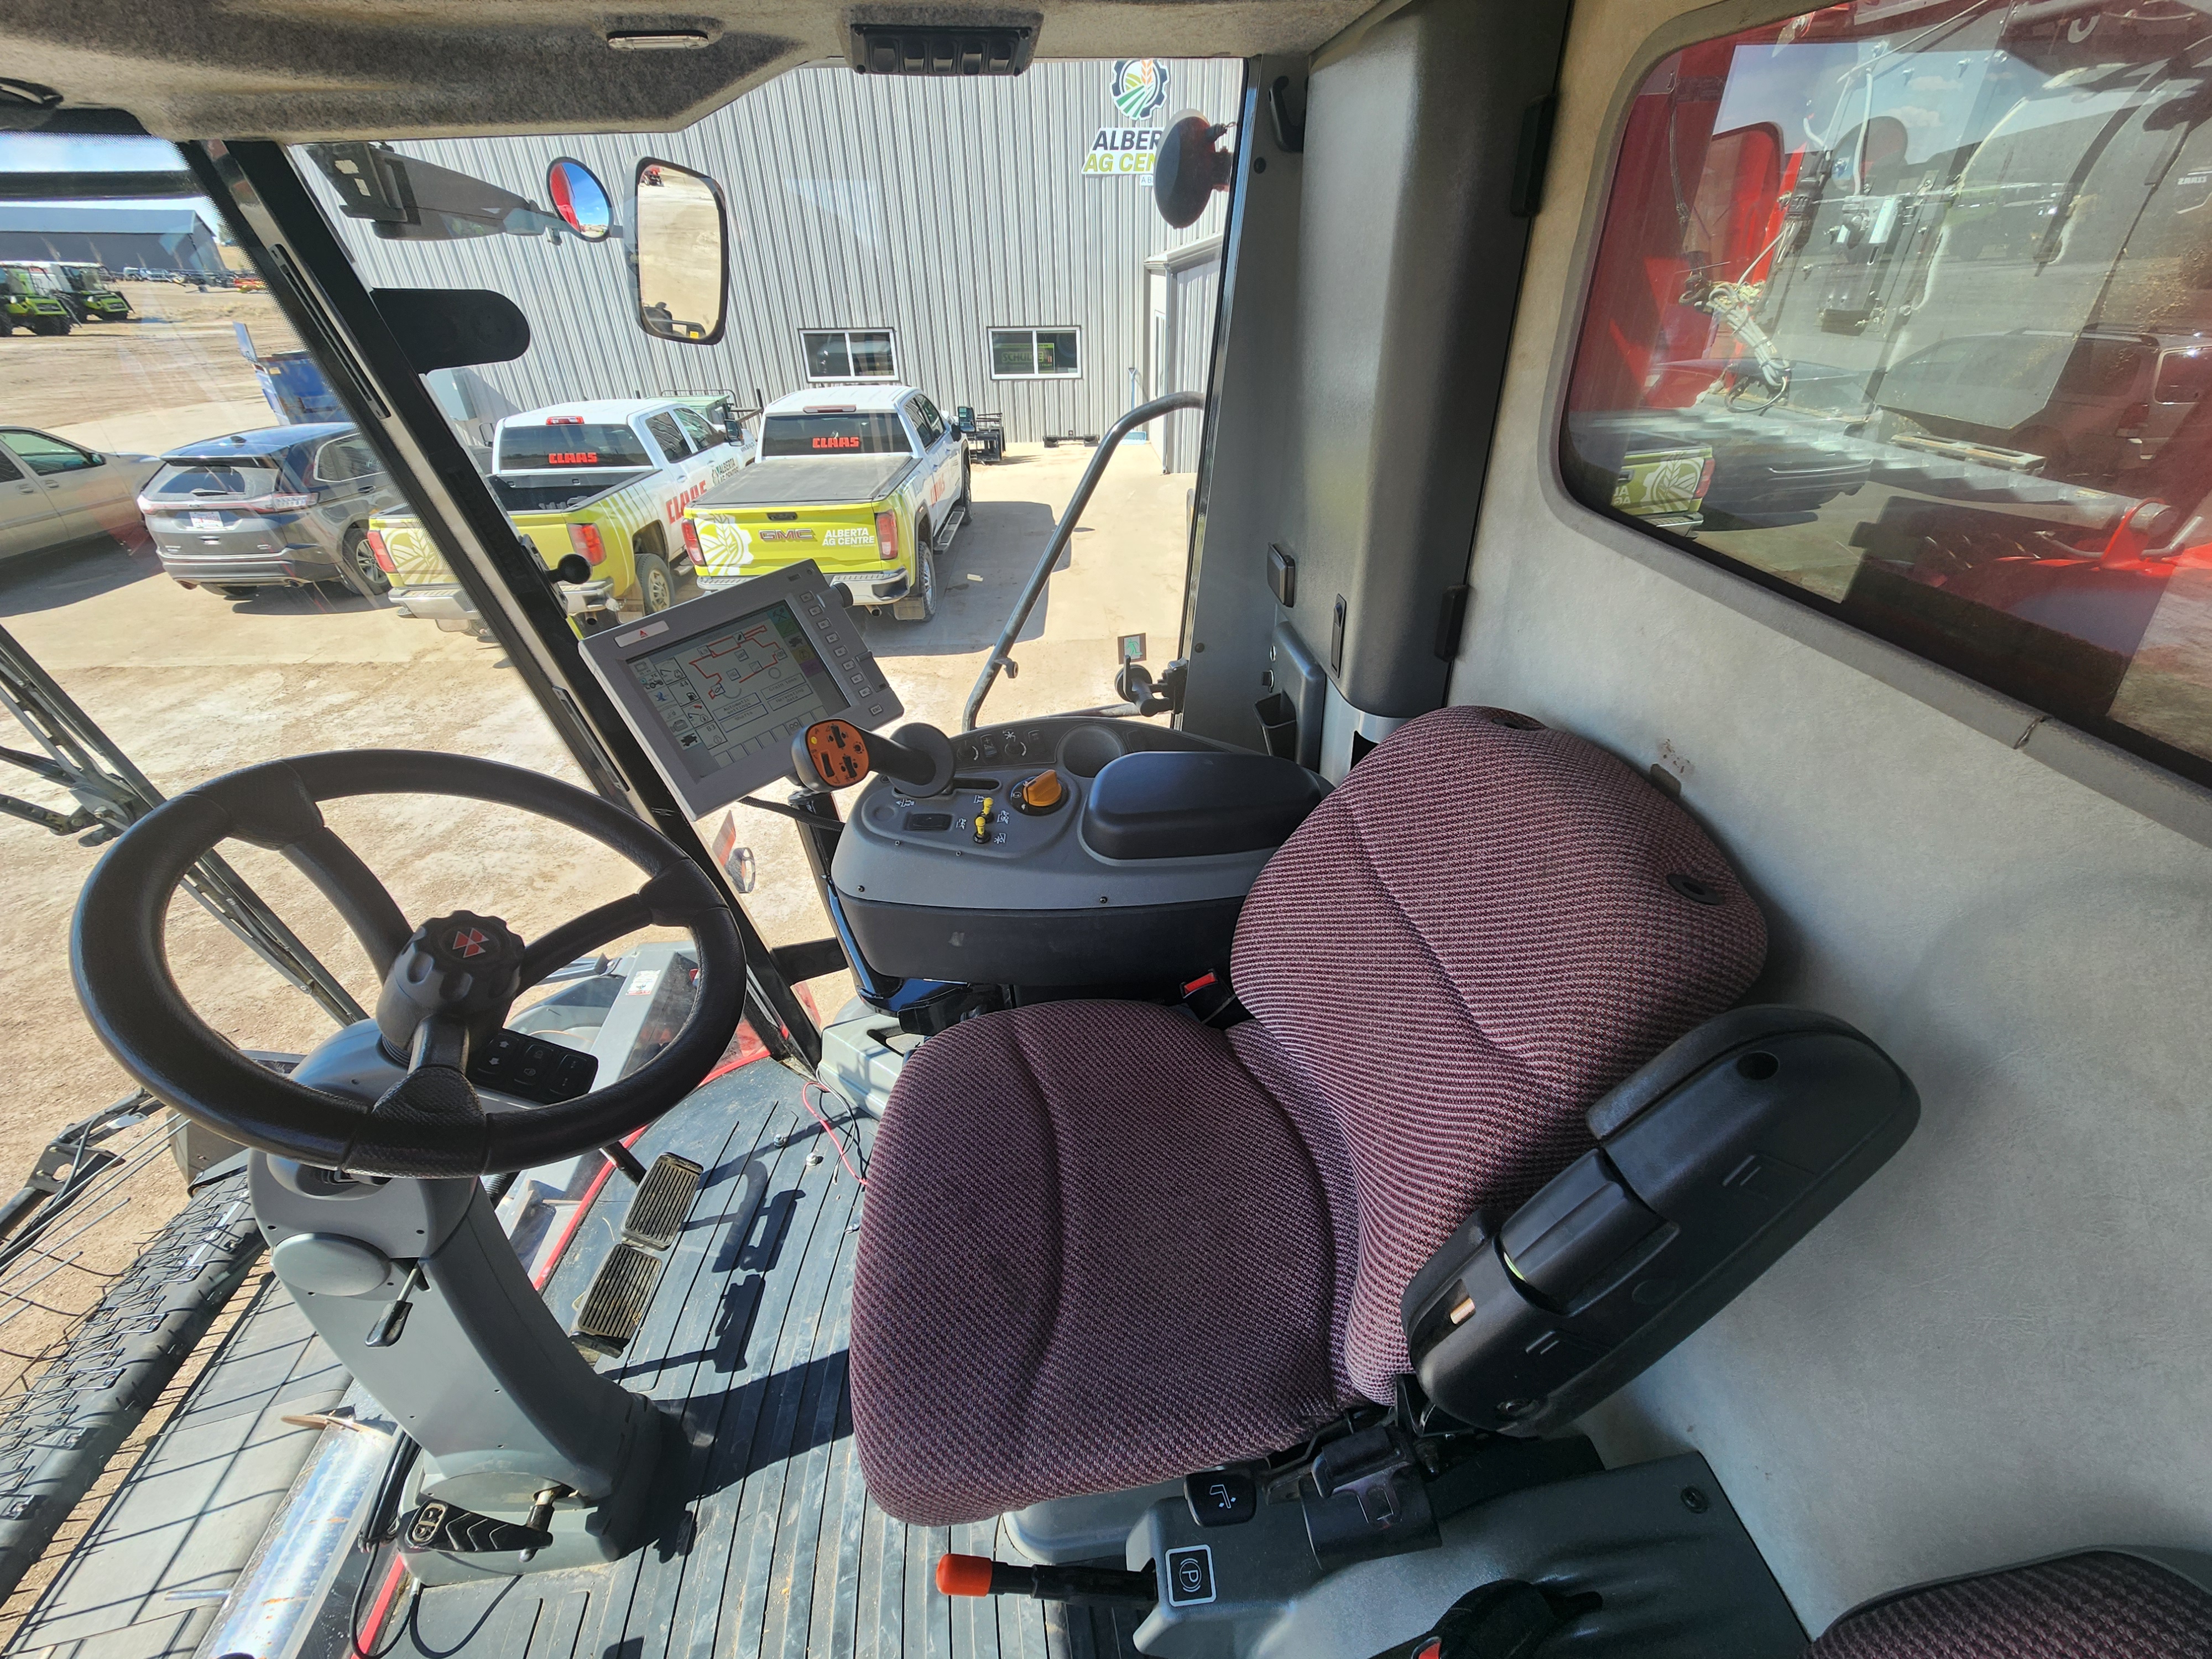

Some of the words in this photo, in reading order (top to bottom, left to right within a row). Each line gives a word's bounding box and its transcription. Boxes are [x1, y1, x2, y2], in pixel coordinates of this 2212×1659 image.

[1083, 153, 1114, 172] AG
[1001, 351, 1044, 363] SCHULE
[812, 436, 859, 448] CLAAS
[549, 452, 597, 464] CLAAS
[758, 528, 813, 540] GMC
[825, 528, 869, 538] ALBERTA
[822, 537, 836, 546] AG
[838, 536, 875, 545] CENTRE
[769, 683, 784, 691] Grain
[775, 688, 804, 703] Harvesting
[723, 698, 750, 712] Automatic
[727, 702, 751, 714] settings
